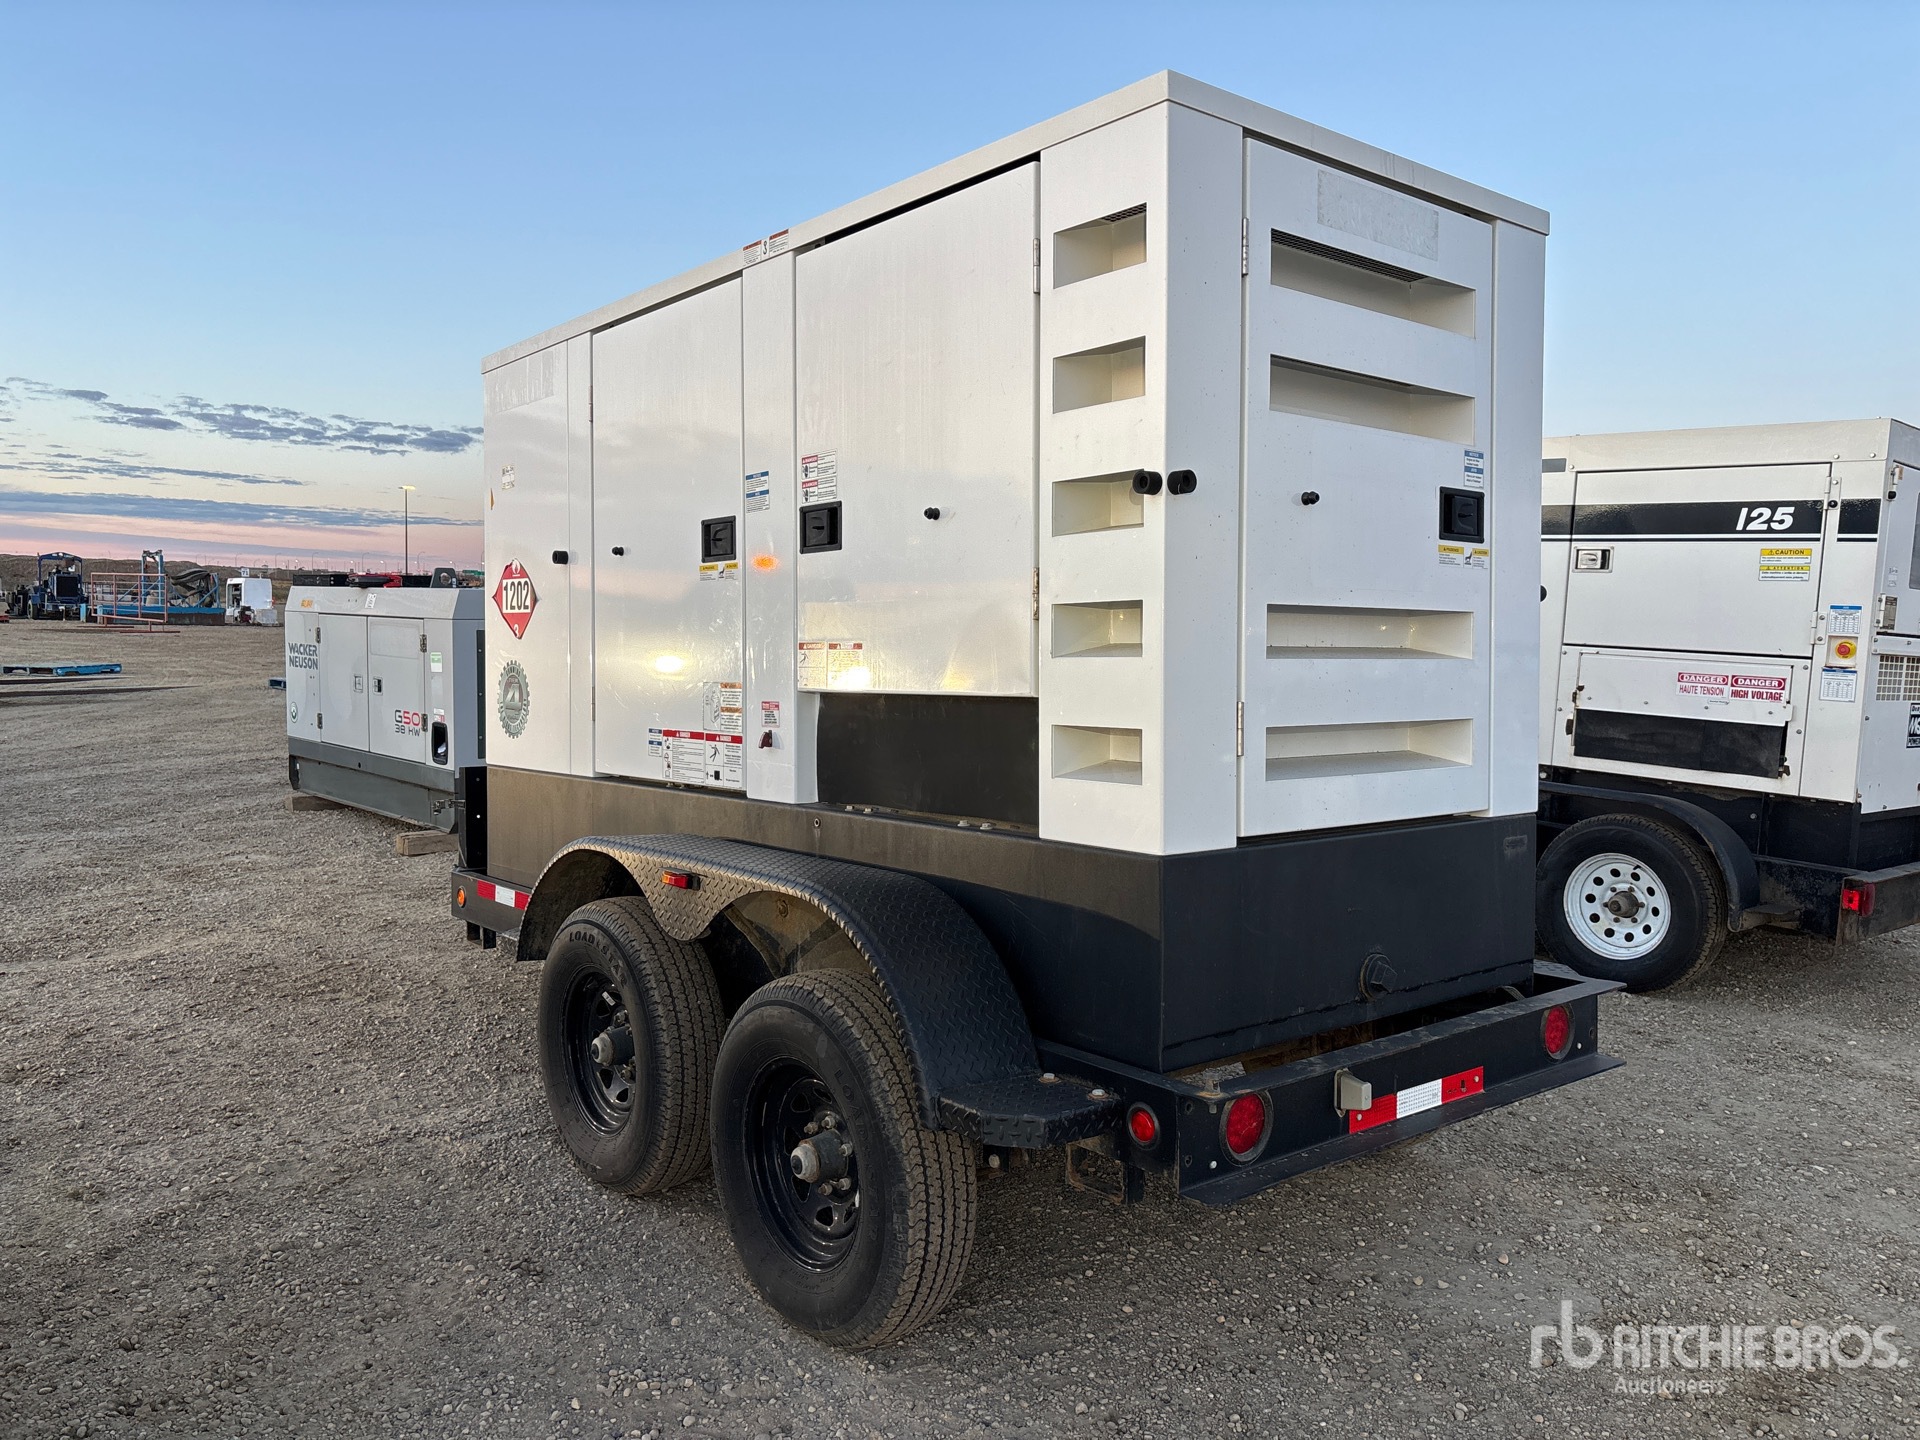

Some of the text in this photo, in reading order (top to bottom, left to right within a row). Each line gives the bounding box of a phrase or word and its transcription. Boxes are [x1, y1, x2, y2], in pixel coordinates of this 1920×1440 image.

[1736, 506, 1795, 530] 125
[503, 580, 530, 611] 1202
[288, 642, 318, 657] WACKER
[289, 655, 319, 670] NEUSON
[1683, 674, 1724, 684] DANGER
[1737, 678, 1779, 687] DANGER
[1679, 684, 1725, 697] HAUTE TENSION
[1730, 688, 1784, 702] HIGH VOLTAGE
[395, 709, 420, 726] G50
[395, 724, 406, 734] 38
[569, 930, 596, 945] LOAD
